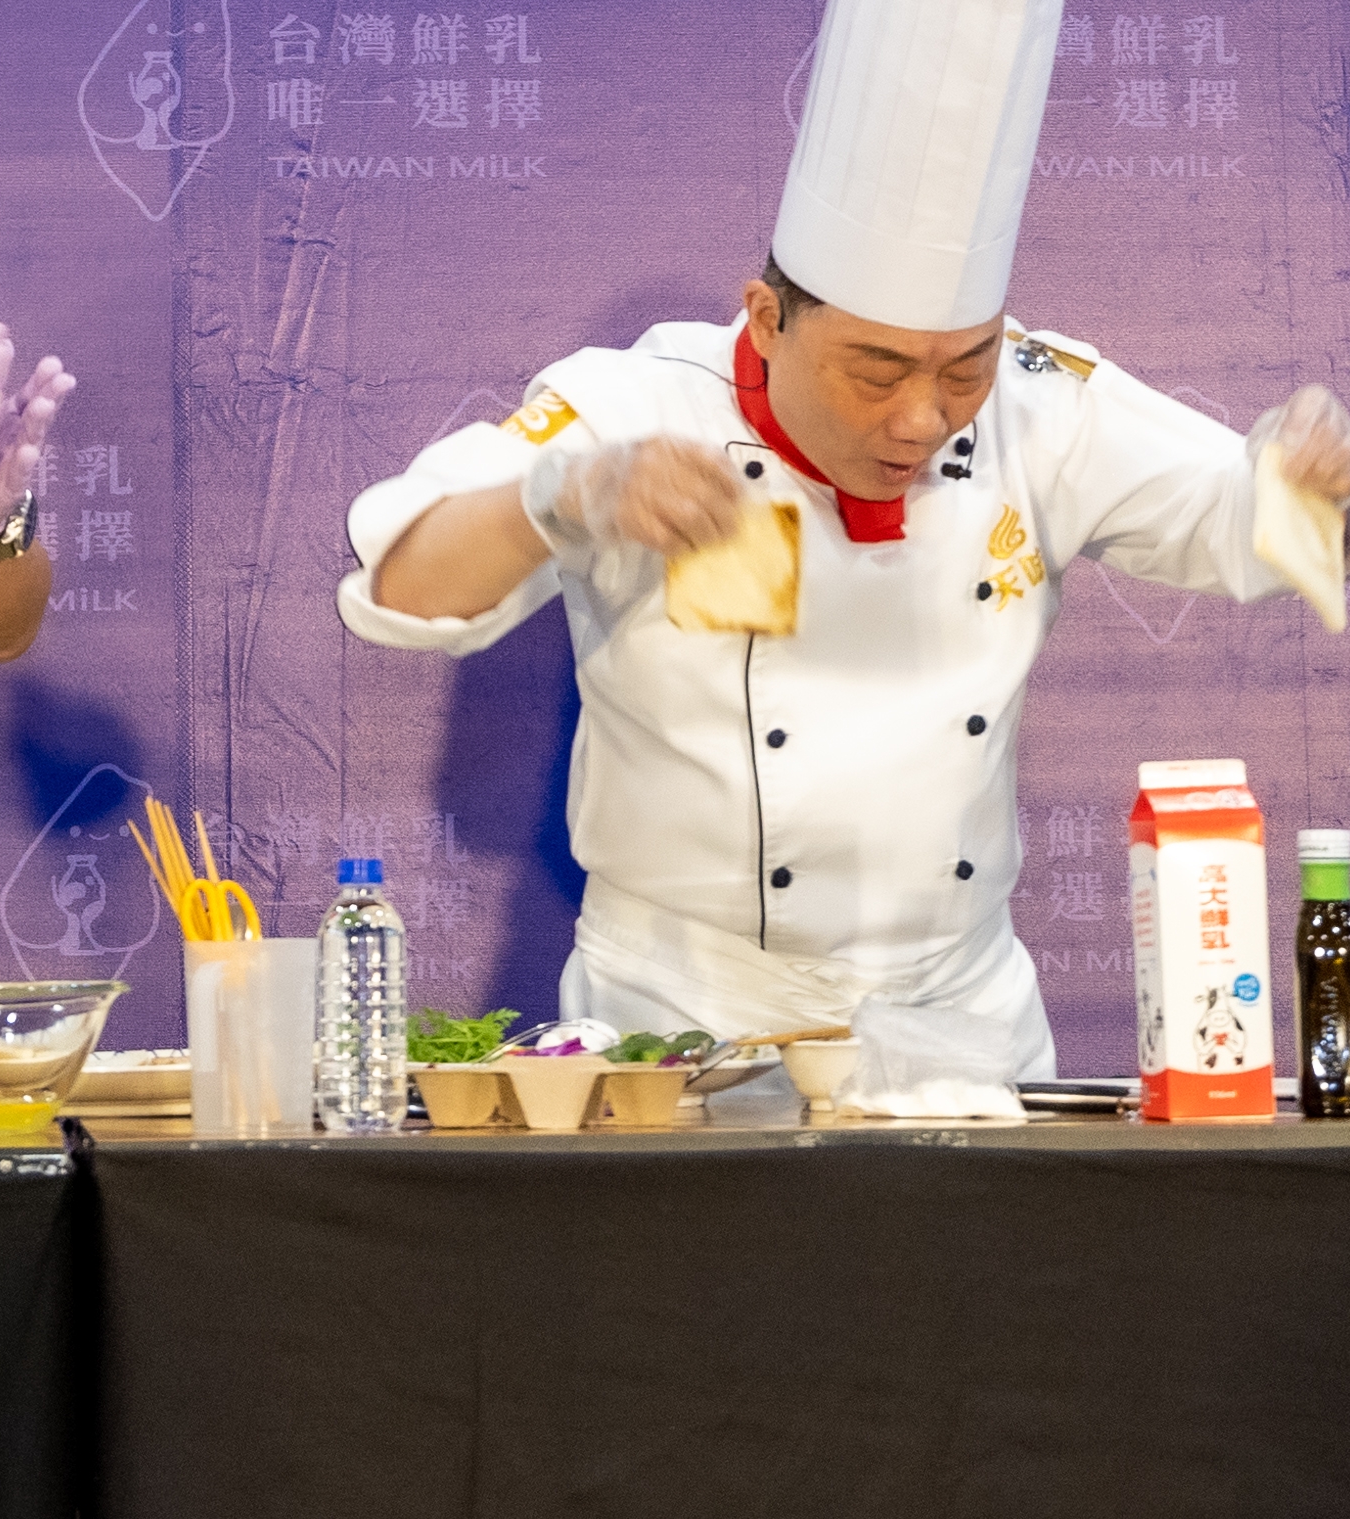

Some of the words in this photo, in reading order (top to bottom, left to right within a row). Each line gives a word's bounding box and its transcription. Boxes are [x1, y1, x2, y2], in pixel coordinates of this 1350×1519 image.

[268, 12, 543, 65] 台灣鮮乳
[266, 78, 544, 129] 唯一選擇
[267, 155, 434, 179] TAIWAN
[449, 153, 548, 179] MiLK
